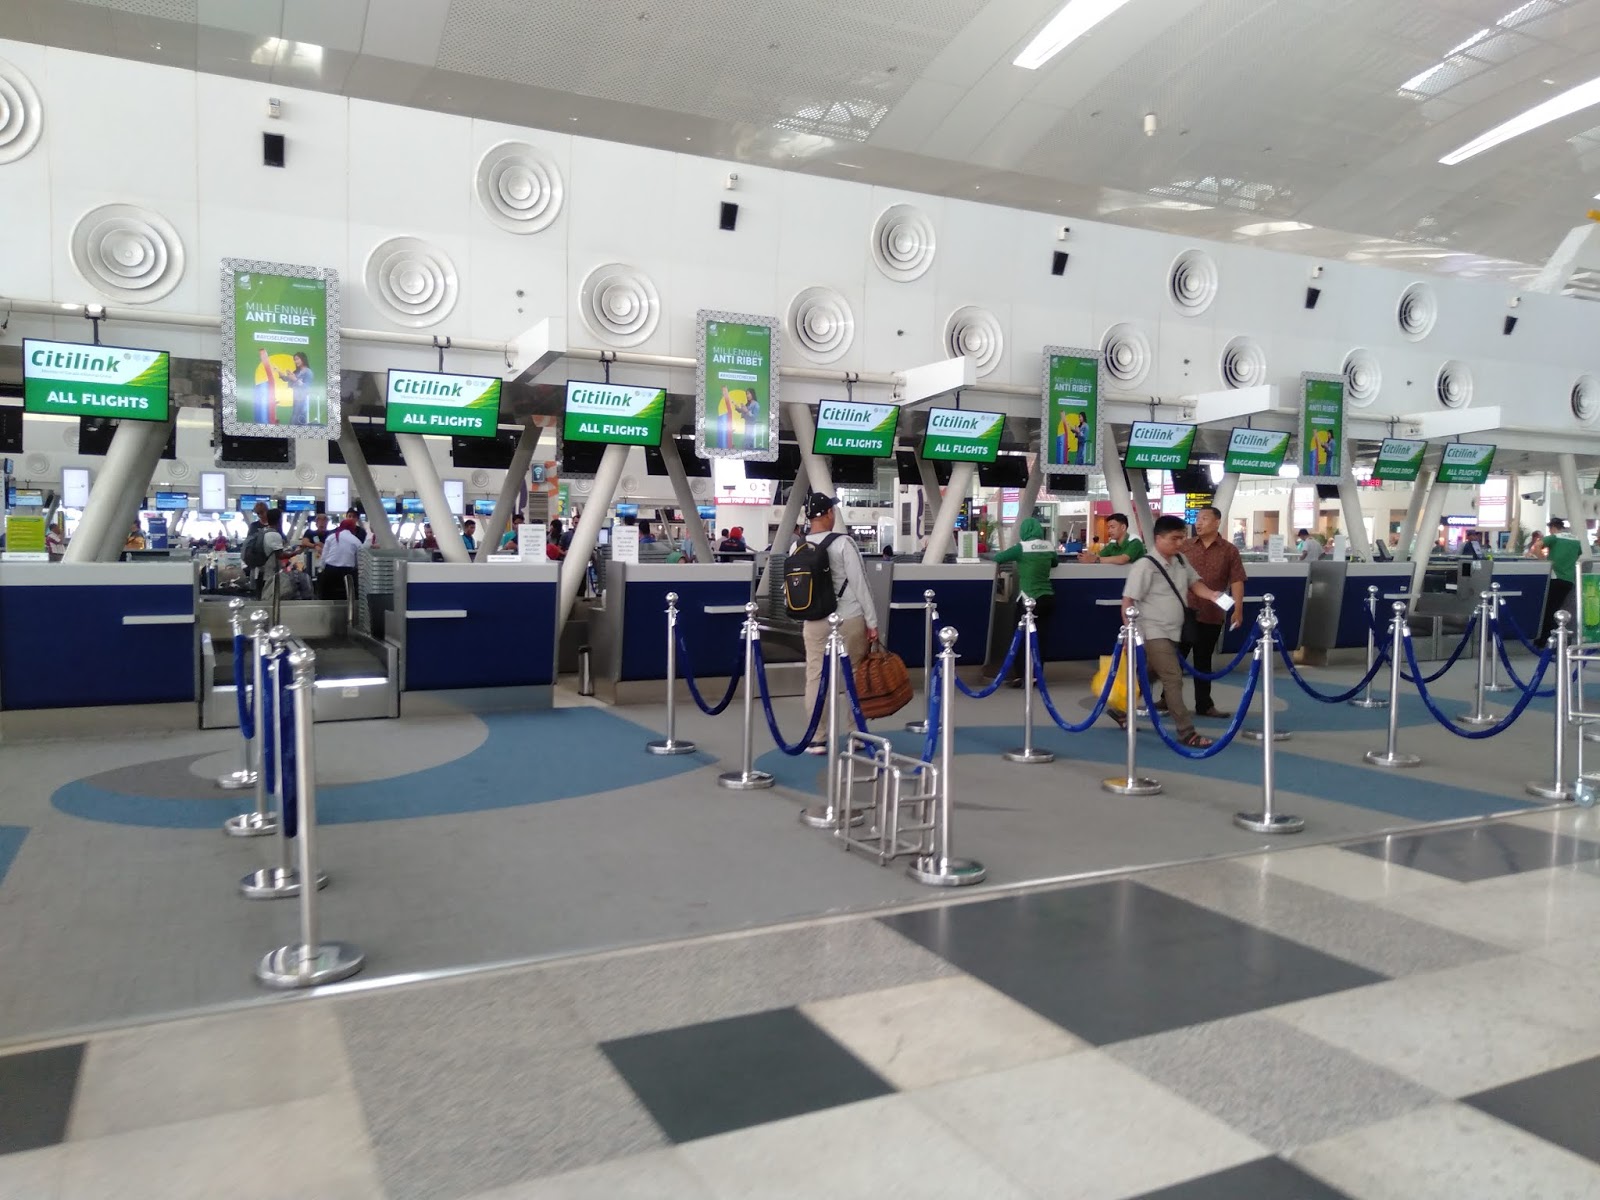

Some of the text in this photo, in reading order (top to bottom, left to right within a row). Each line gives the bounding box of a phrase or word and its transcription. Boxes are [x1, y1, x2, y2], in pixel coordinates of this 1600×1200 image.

[245, 301, 316, 316] MILLENNIAL
[245, 310, 317, 327] ANTI RIBET
[713, 346, 763, 358] MILLENNIAL
[31, 349, 121, 373] Citilink
[712, 353, 763, 367] ANTI RIBET
[393, 378, 464, 397] Citilink
[1054, 383, 1092, 393] ANTI RIBET
[46, 390, 149, 409] ALL FLIGHTS
[571, 389, 632, 407] Citilink
[402, 413, 483, 428] ALL FLIGHTS
[822, 407, 873, 423] Citilink
[932, 414, 979, 430] Citilink
[578, 422, 649, 437] ALL FLIGHTS
[1134, 427, 1174, 441] Citilink
[826, 437, 883, 449] ALL FLIGHTS
[1233, 433, 1270, 447] Citilink
[934, 443, 989, 455] ALL FLIGHTS
[1383, 443, 1411, 455] Citilink
[1447, 448, 1478, 459] Citilink
[1135, 453, 1181, 463] ALL FLIGHTS
[1231, 458, 1276, 468] BAGGAGE DROP
[1446, 468, 1482, 477] ALL FLIGHTS
